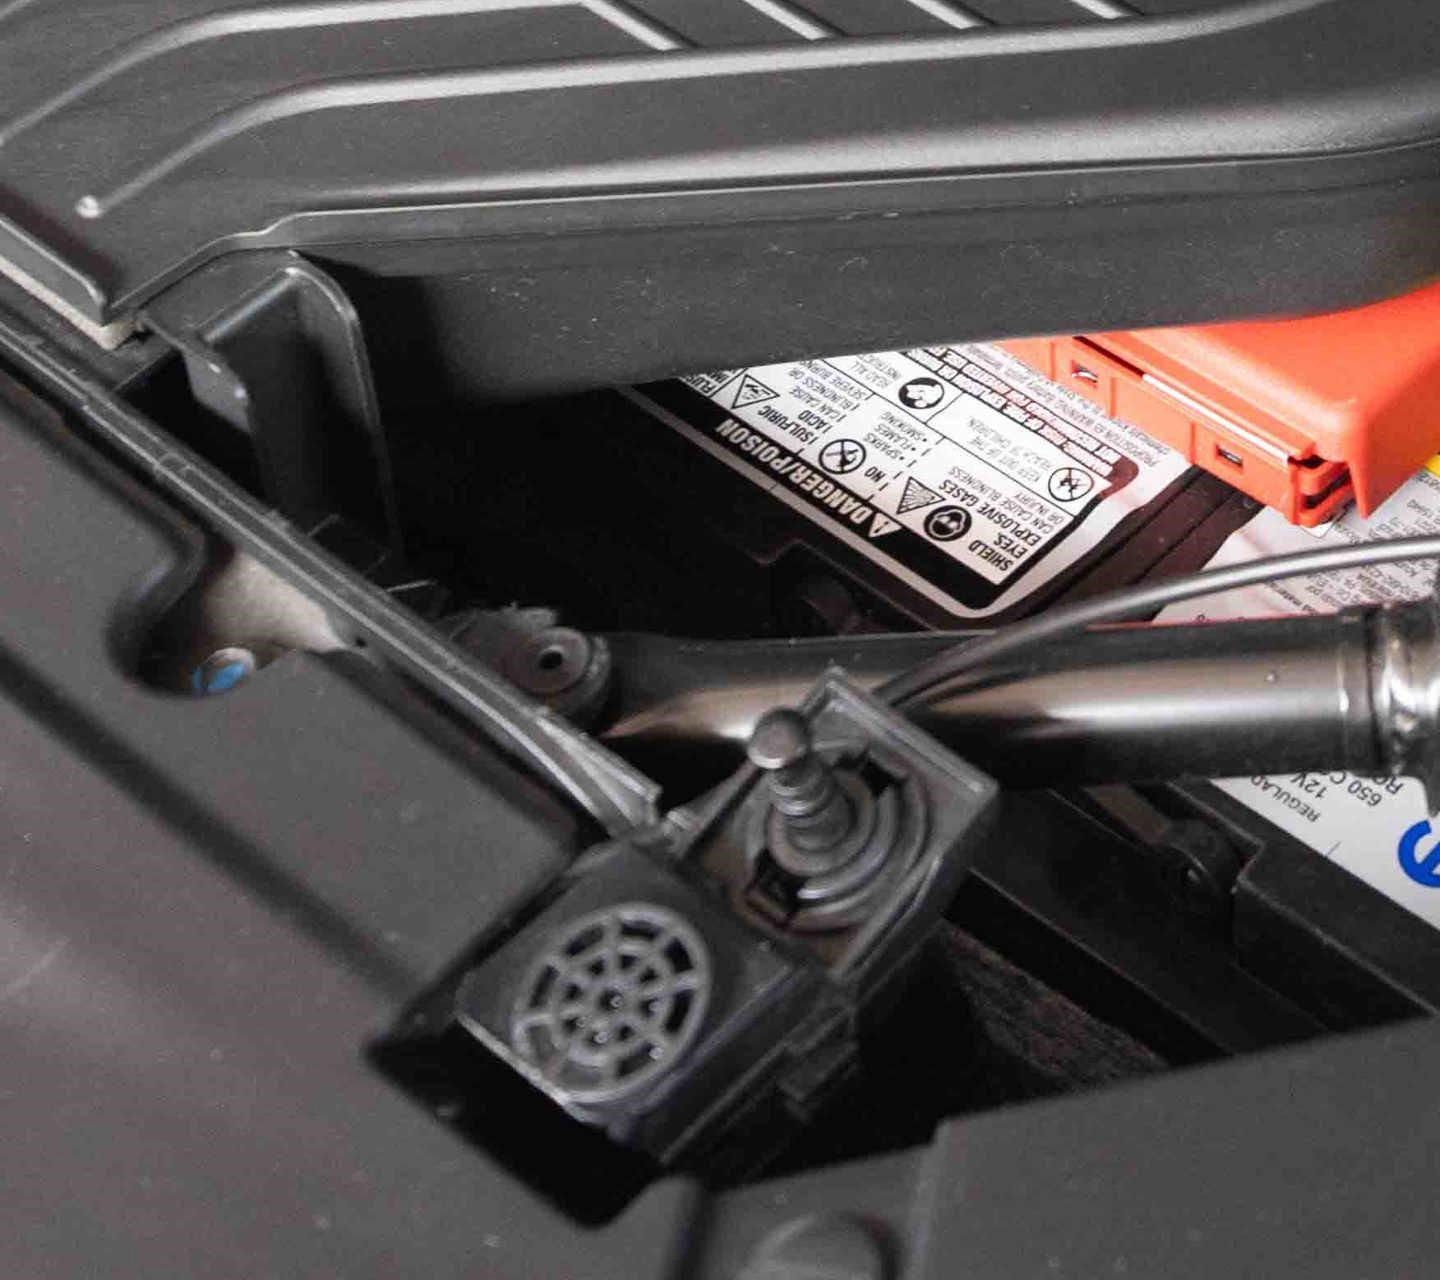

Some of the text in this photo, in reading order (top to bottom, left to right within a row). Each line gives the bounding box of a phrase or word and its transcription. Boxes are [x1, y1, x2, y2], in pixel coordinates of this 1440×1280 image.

[788, 385, 842, 420] CAN CAUSE
[800, 375, 854, 411] BLINDNESS
[829, 375, 866, 401] SEVERE
[757, 404, 813, 442] SULFURIC
[797, 408, 827, 430] ACID
[713, 416, 873, 524] DANGER/POISON
[863, 465, 886, 483] NO
[938, 478, 1042, 546] EXPLOSIVE GASES
[948, 465, 1055, 535] CAN CAUSE BLINDNESS
[1046, 511, 1065, 525] OR
[966, 539, 1014, 572] SHIELD
[1346, 779, 1382, 807] 650
